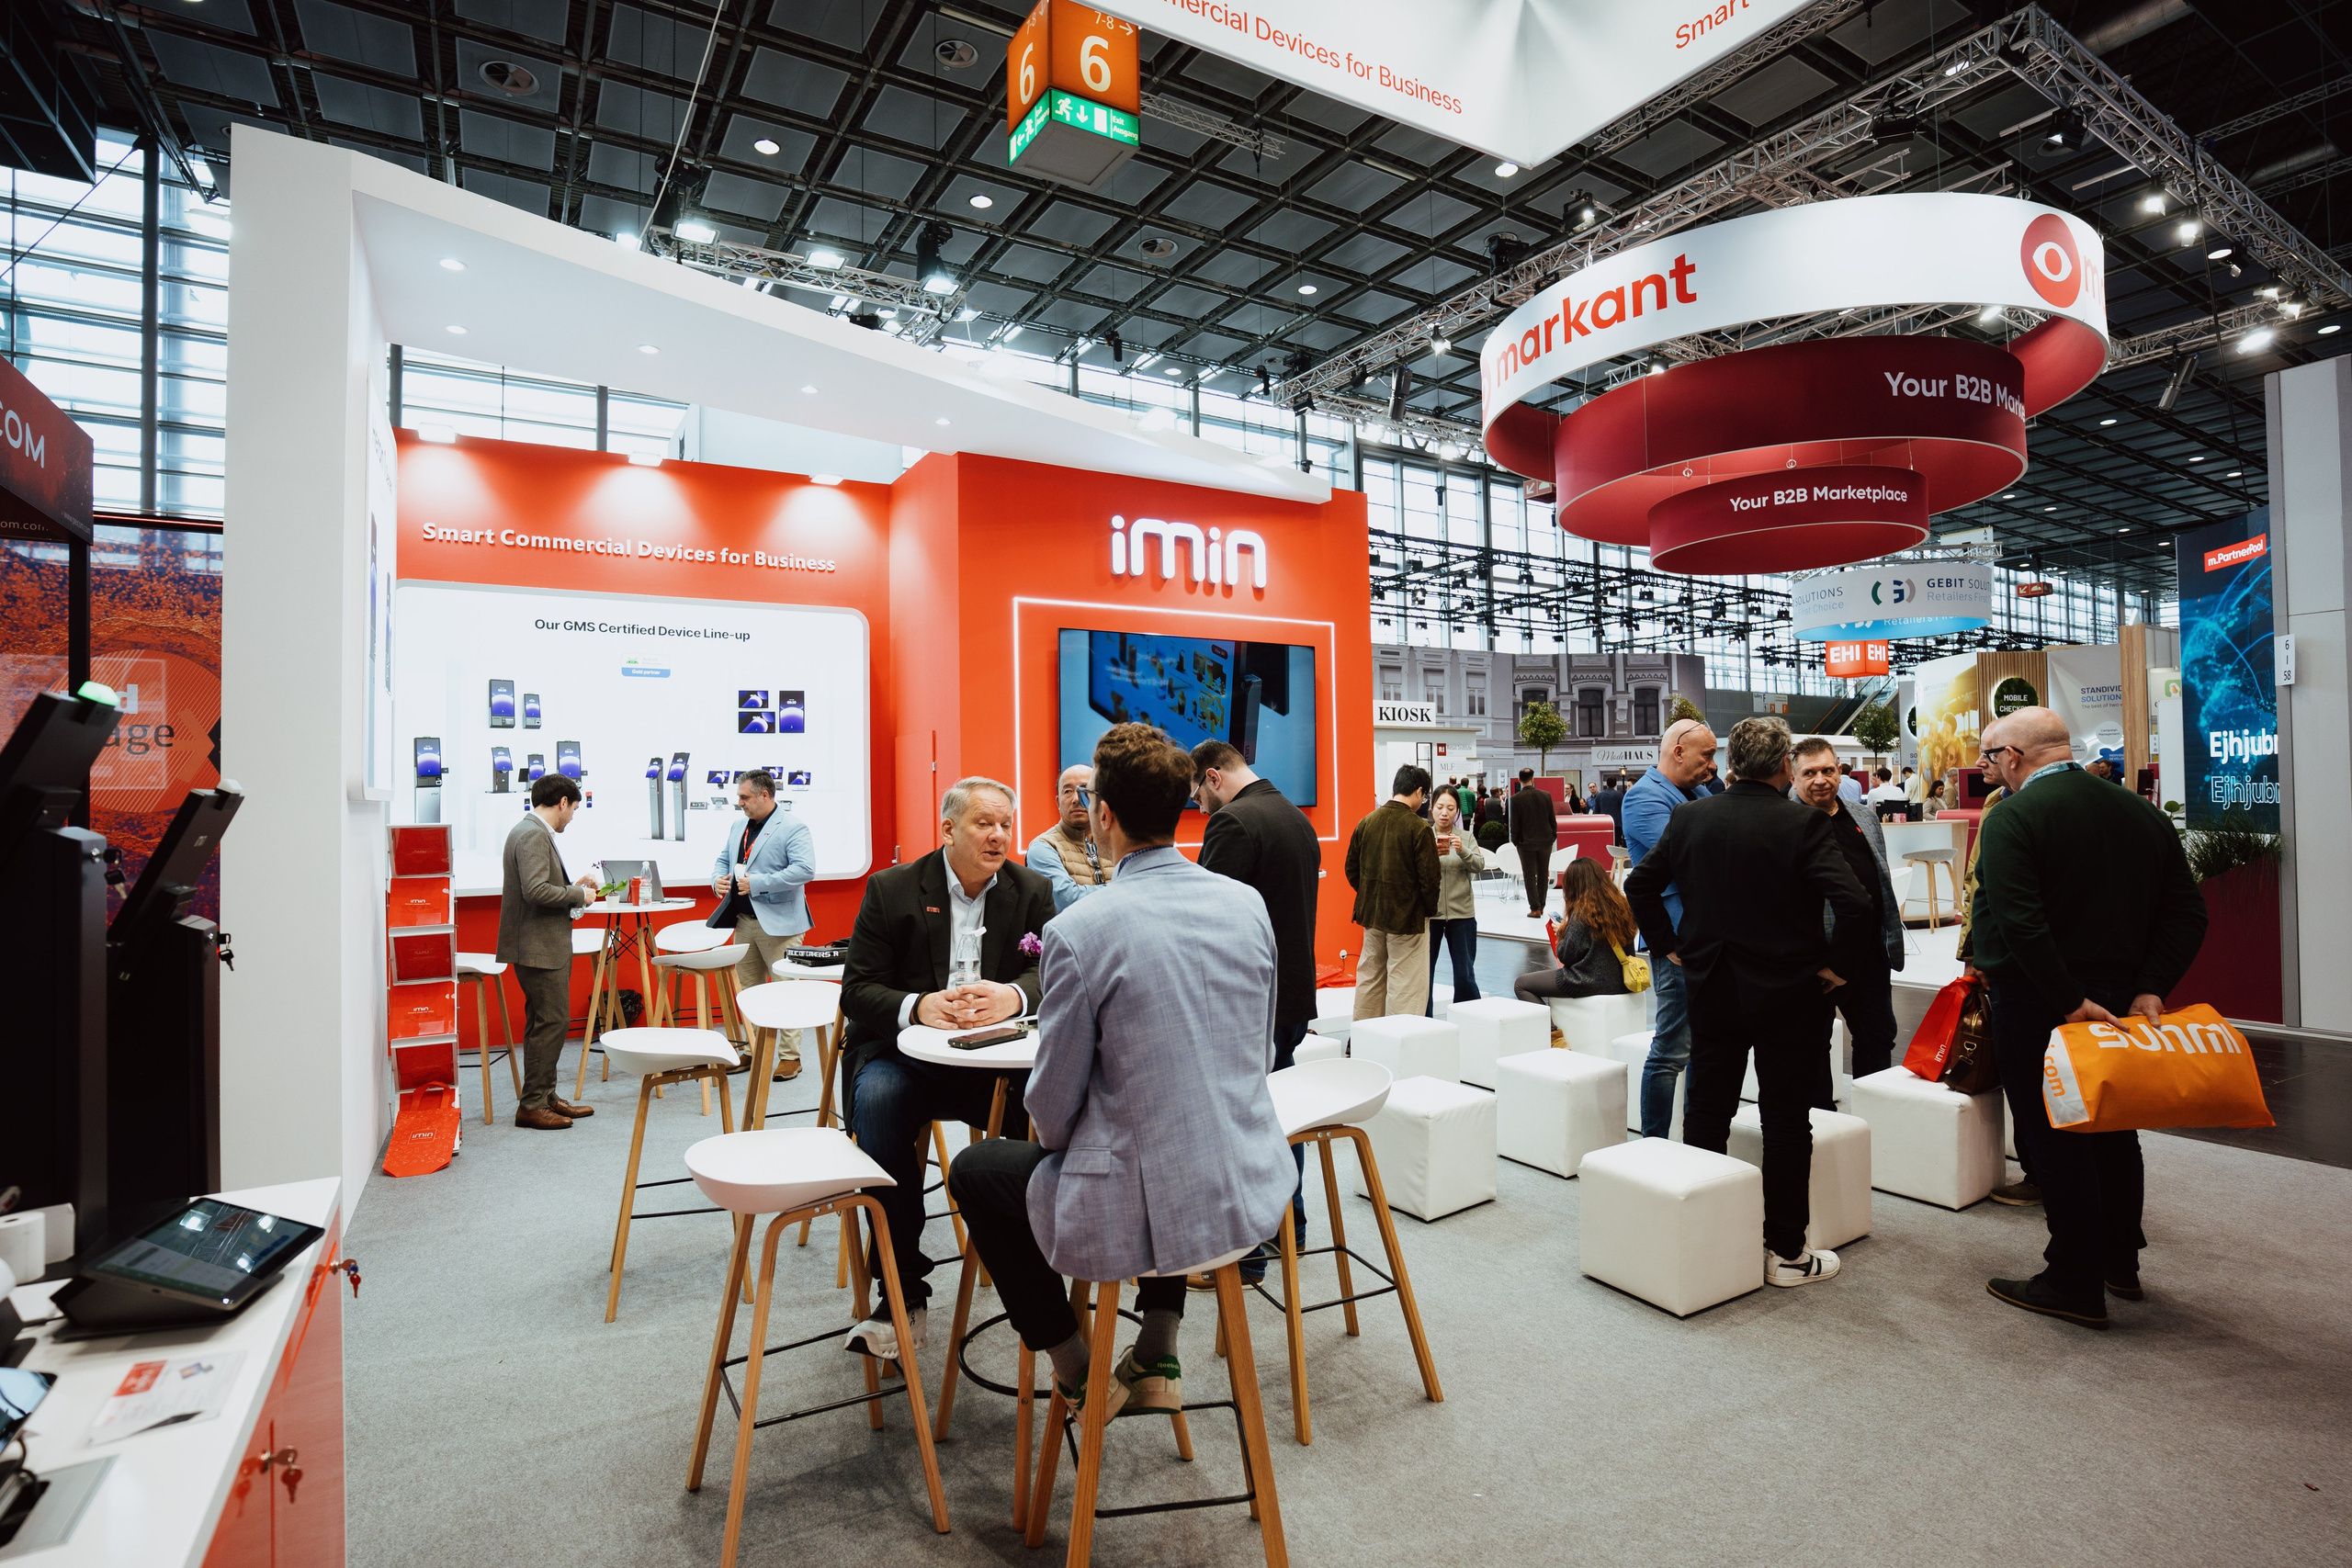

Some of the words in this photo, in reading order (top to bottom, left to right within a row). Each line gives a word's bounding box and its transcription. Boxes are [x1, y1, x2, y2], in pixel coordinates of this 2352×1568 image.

[1094, 10, 1114, 29] 7-8
[1080, 35, 1112, 93] 6
[1255, 16, 1340, 69] Devices
[1345, 52, 1374, 81] for
[1379, 64, 1463, 115] Business
[1020, 42, 1035, 106] 6
[1113, 115, 1125, 126] Exit
[1113, 125, 1138, 141] Ausgang
[1497, 253, 1697, 389] markant
[1883, 371, 1948, 398] Your
[1955, 374, 1992, 404] B2B
[0, 400, 45, 469] OM
[1729, 495, 1770, 512] Your
[1773, 488, 1808, 505] B2B
[1813, 484, 1907, 503] Marketplace
[423, 522, 495, 546] Smart
[500, 529, 631, 558] Commercial
[638, 540, 717, 564] Devices
[719, 547, 750, 566] for
[754, 551, 836, 573] Business
[2208, 538, 2264, 567] m.PartnerPool
[1927, 578, 1964, 589] GEBIT
[1794, 586, 1844, 606] SOLUTIONS
[1927, 591, 1973, 602] Retailers
[1813, 601, 1844, 614] Choice
[535, 618, 560, 630] Our
[563, 620, 595, 632] GMS
[598, 623, 656, 636] Certified
[658, 626, 701, 637] Device
[703, 628, 751, 642] Line-up
[1829, 644, 1860, 663] EHI
[1867, 643, 1886, 661] EHI
[2285, 639, 2290, 649] 6
[2283, 670, 2291, 681] 58
[1378, 706, 1432, 723] KIOSK
